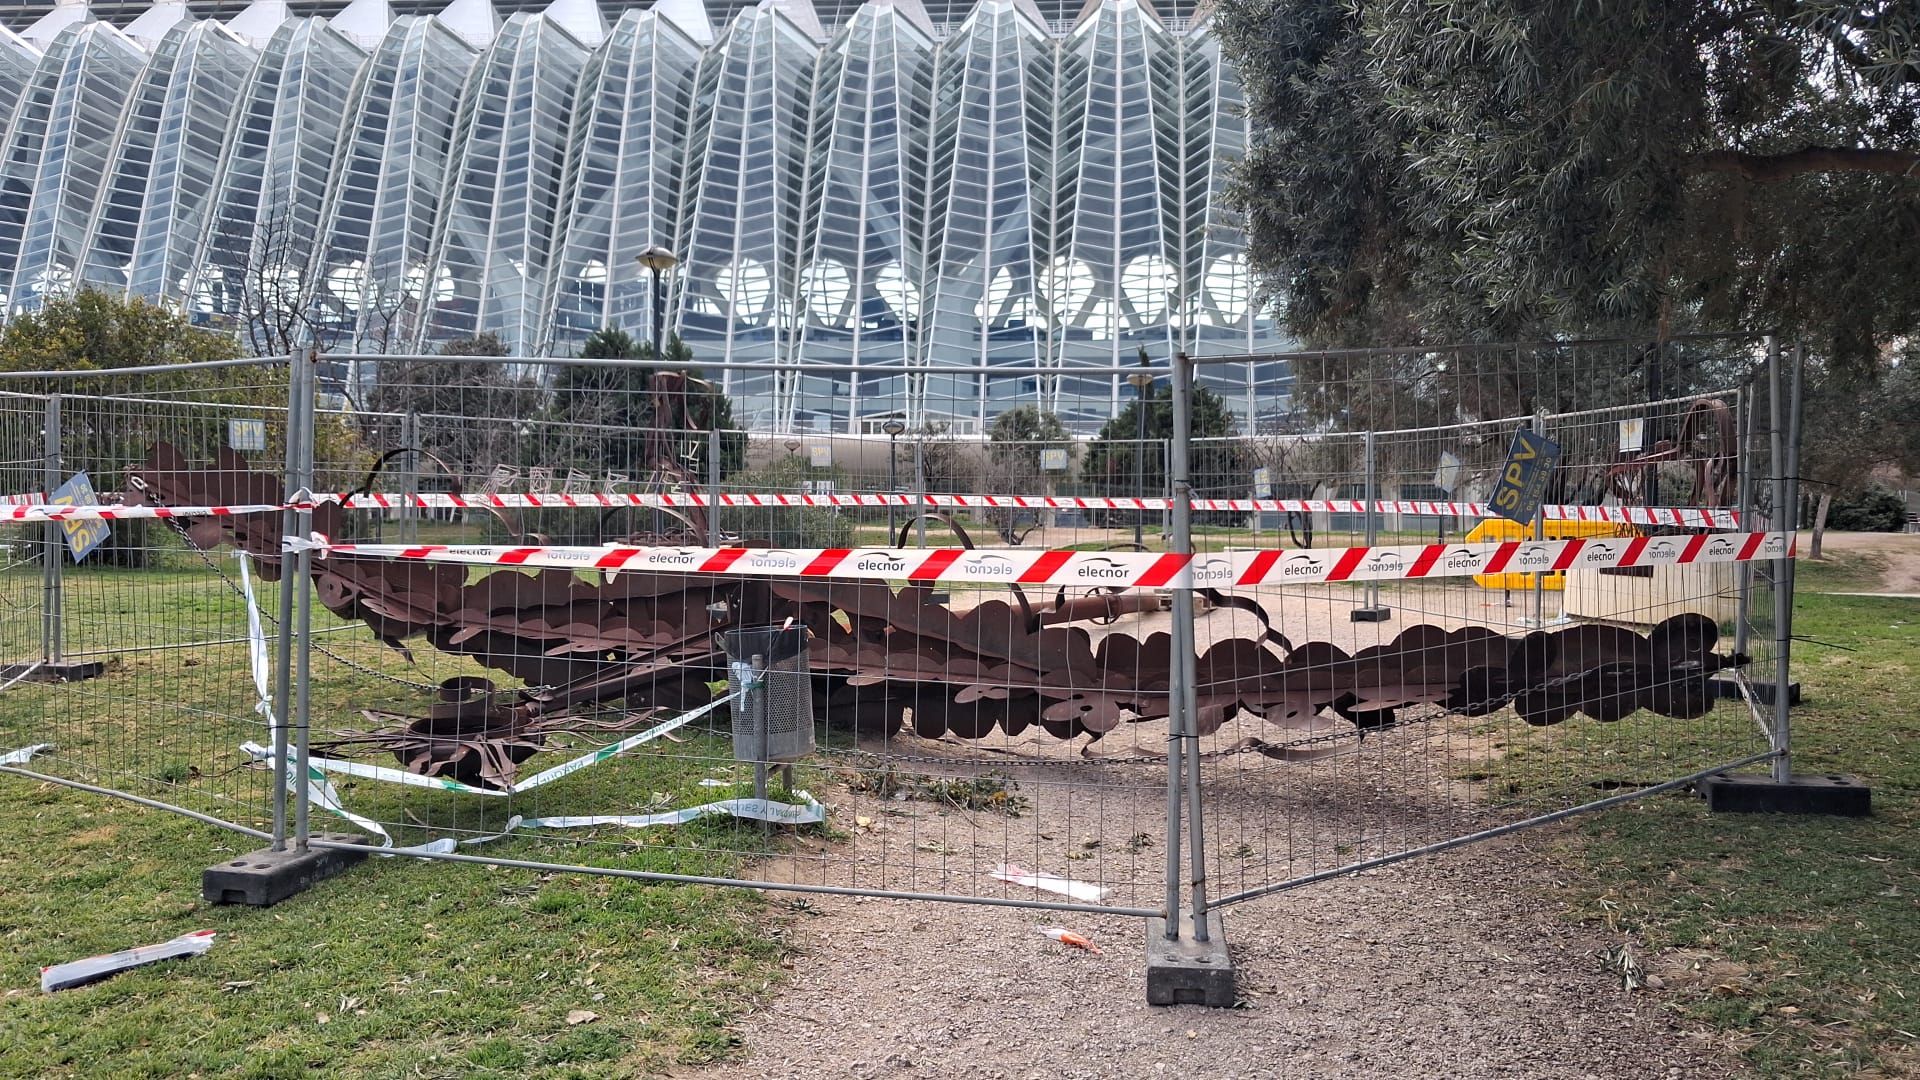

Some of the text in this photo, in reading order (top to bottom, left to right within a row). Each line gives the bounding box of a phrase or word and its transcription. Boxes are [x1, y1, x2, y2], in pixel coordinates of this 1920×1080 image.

[233, 421, 262, 436] SPV
[1496, 436, 1537, 511] SPV
[1586, 551, 1616, 562] elecnor
[1708, 545, 1736, 556] elecnor
[648, 553, 696, 565] elecnor
[857, 559, 906, 571] elecnor
[1447, 557, 1481, 569] elecnor
[1078, 565, 1130, 578] elecnor
[1284, 564, 1324, 576] elecnor
